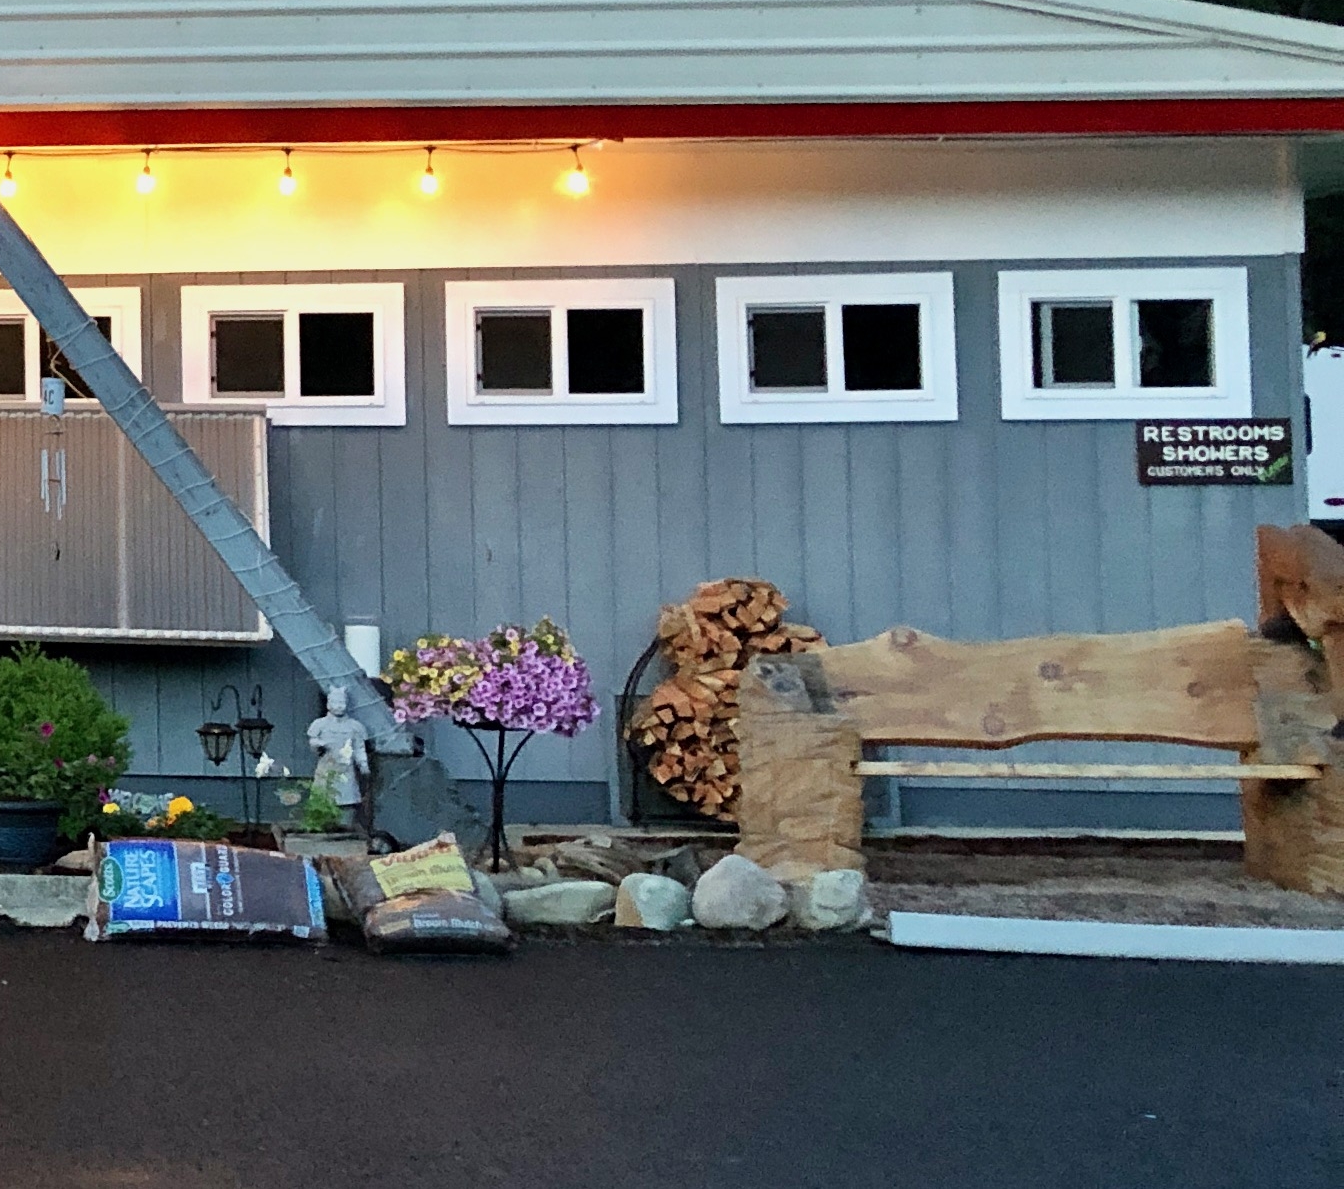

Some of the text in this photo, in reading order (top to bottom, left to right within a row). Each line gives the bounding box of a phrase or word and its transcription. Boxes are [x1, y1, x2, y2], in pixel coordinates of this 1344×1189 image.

[1143, 425, 1285, 442] RESTROOMS
[1162, 445, 1270, 461] SHOWERS
[1147, 466, 1265, 477] CUSTOMERS ONLY
[124, 850, 141, 908] NATURE
[140, 849, 163, 908] SCAPES
[220, 884, 234, 917] COLOR
